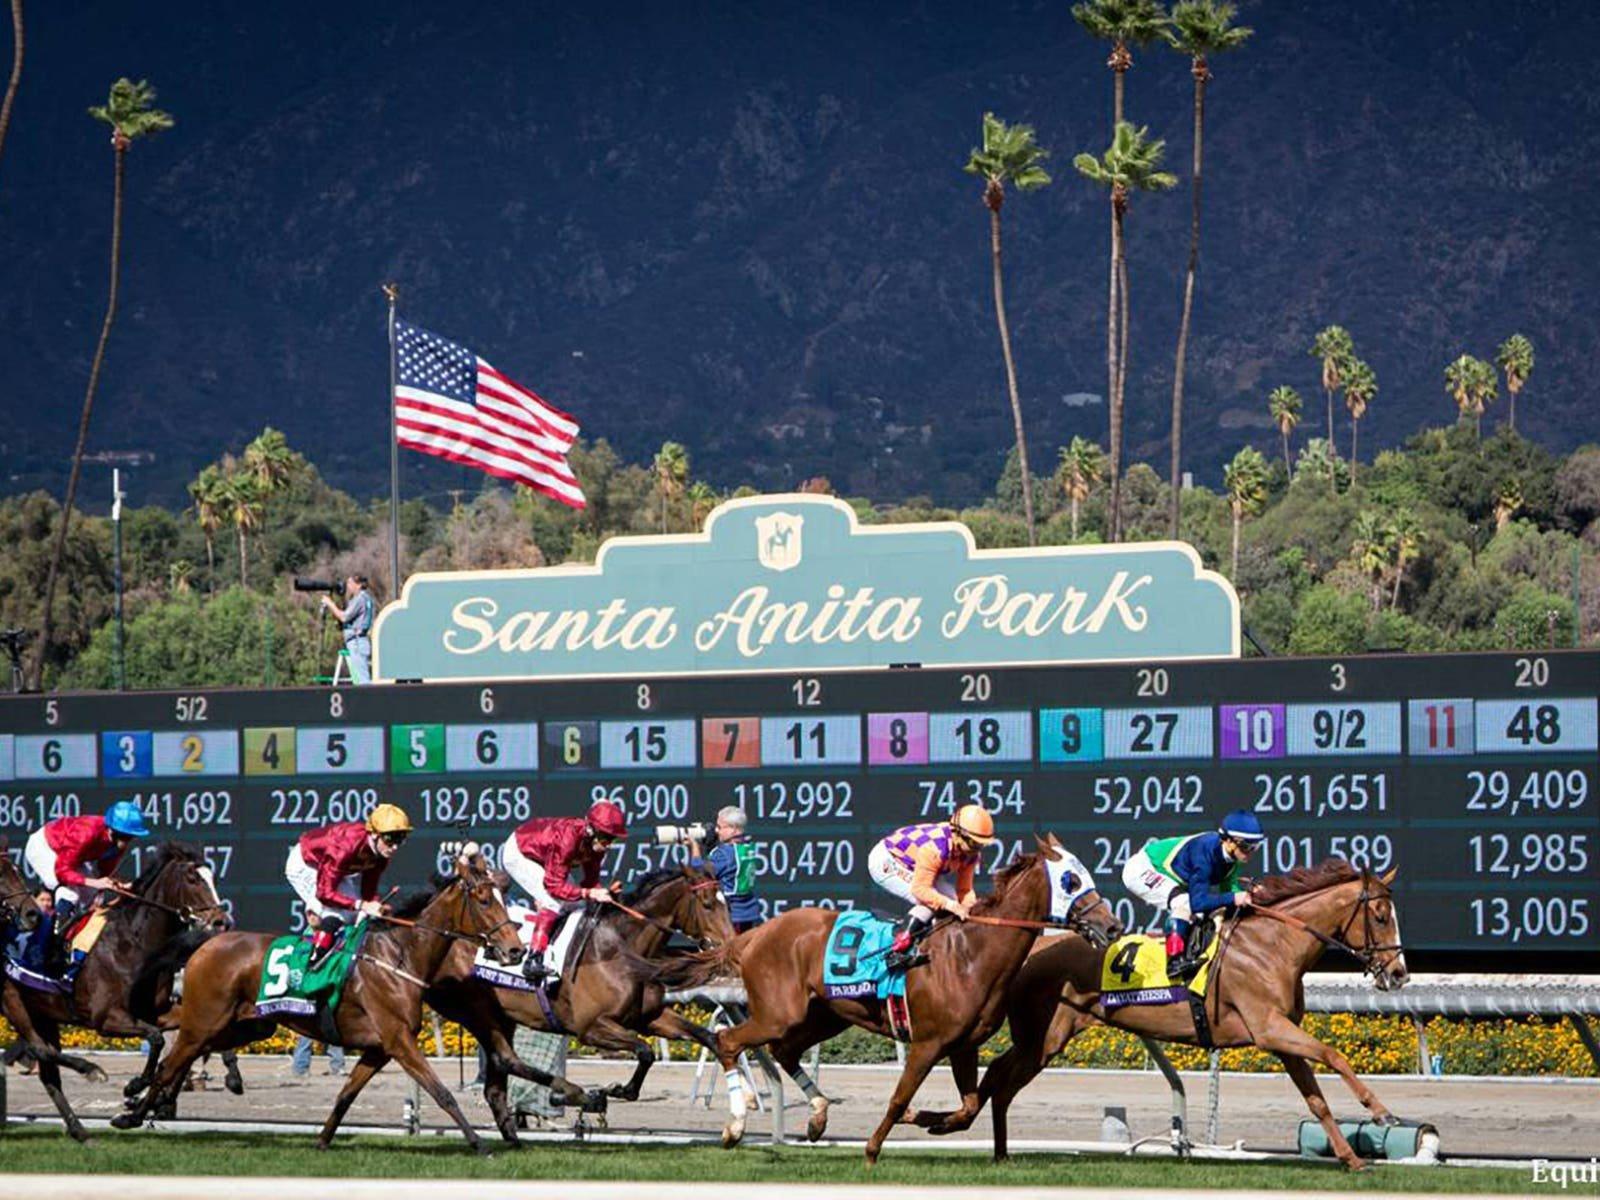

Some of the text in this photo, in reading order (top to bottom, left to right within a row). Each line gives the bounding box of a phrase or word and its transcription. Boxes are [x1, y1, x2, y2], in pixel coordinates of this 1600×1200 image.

[443, 597, 677, 654] Santa
[695, 584, 922, 657] Anita
[961, 674, 991, 701] 20
[1137, 669, 1169, 696] 20
[1330, 664, 1346, 691] 3
[1515, 657, 1549, 687] 20
[176, 697, 208, 721] 5/2
[330, 693, 344, 718] 8
[480, 688, 494, 713] 6
[637, 684, 651, 710] 8
[792, 679, 821, 705] 12
[46, 701, 59, 725] 5
[1235, 710, 1273, 752] 10
[1313, 709, 1366, 749] 9/2
[1425, 705, 1455, 748] 11
[1506, 705, 1561, 745] 48
[262, 733, 280, 769] 4
[327, 734, 347, 767] 5
[410, 729, 428, 767] 5
[476, 730, 499, 764] 6
[563, 726, 581, 765] 6
[624, 726, 666, 762] 15
[723, 723, 740, 762] 7
[786, 722, 826, 759] 11
[890, 718, 907, 758] 8
[955, 718, 1000, 756] 18
[1062, 714, 1081, 754] 9
[1130, 714, 1179, 752] 27
[43, 740, 63, 772] 6
[119, 736, 136, 772] 3
[181, 736, 204, 772] 2
[271, 789, 378, 828] 222,608
[420, 786, 531, 826] 182,658
[735, 781, 853, 824] 112,992
[918, 779, 1025, 816] 74354
[1093, 775, 1204, 819] 52,042
[1254, 773, 1387, 817] 261,651
[1466, 770, 1588, 816] 29,409
[1258, 834, 1393, 873] 101589
[1469, 833, 1588, 879] 12,985
[1470, 897, 1589, 942] 13,005
[264, 944, 295, 996] 5
[830, 925, 865, 977] 9
[1109, 941, 1144, 983] 4
